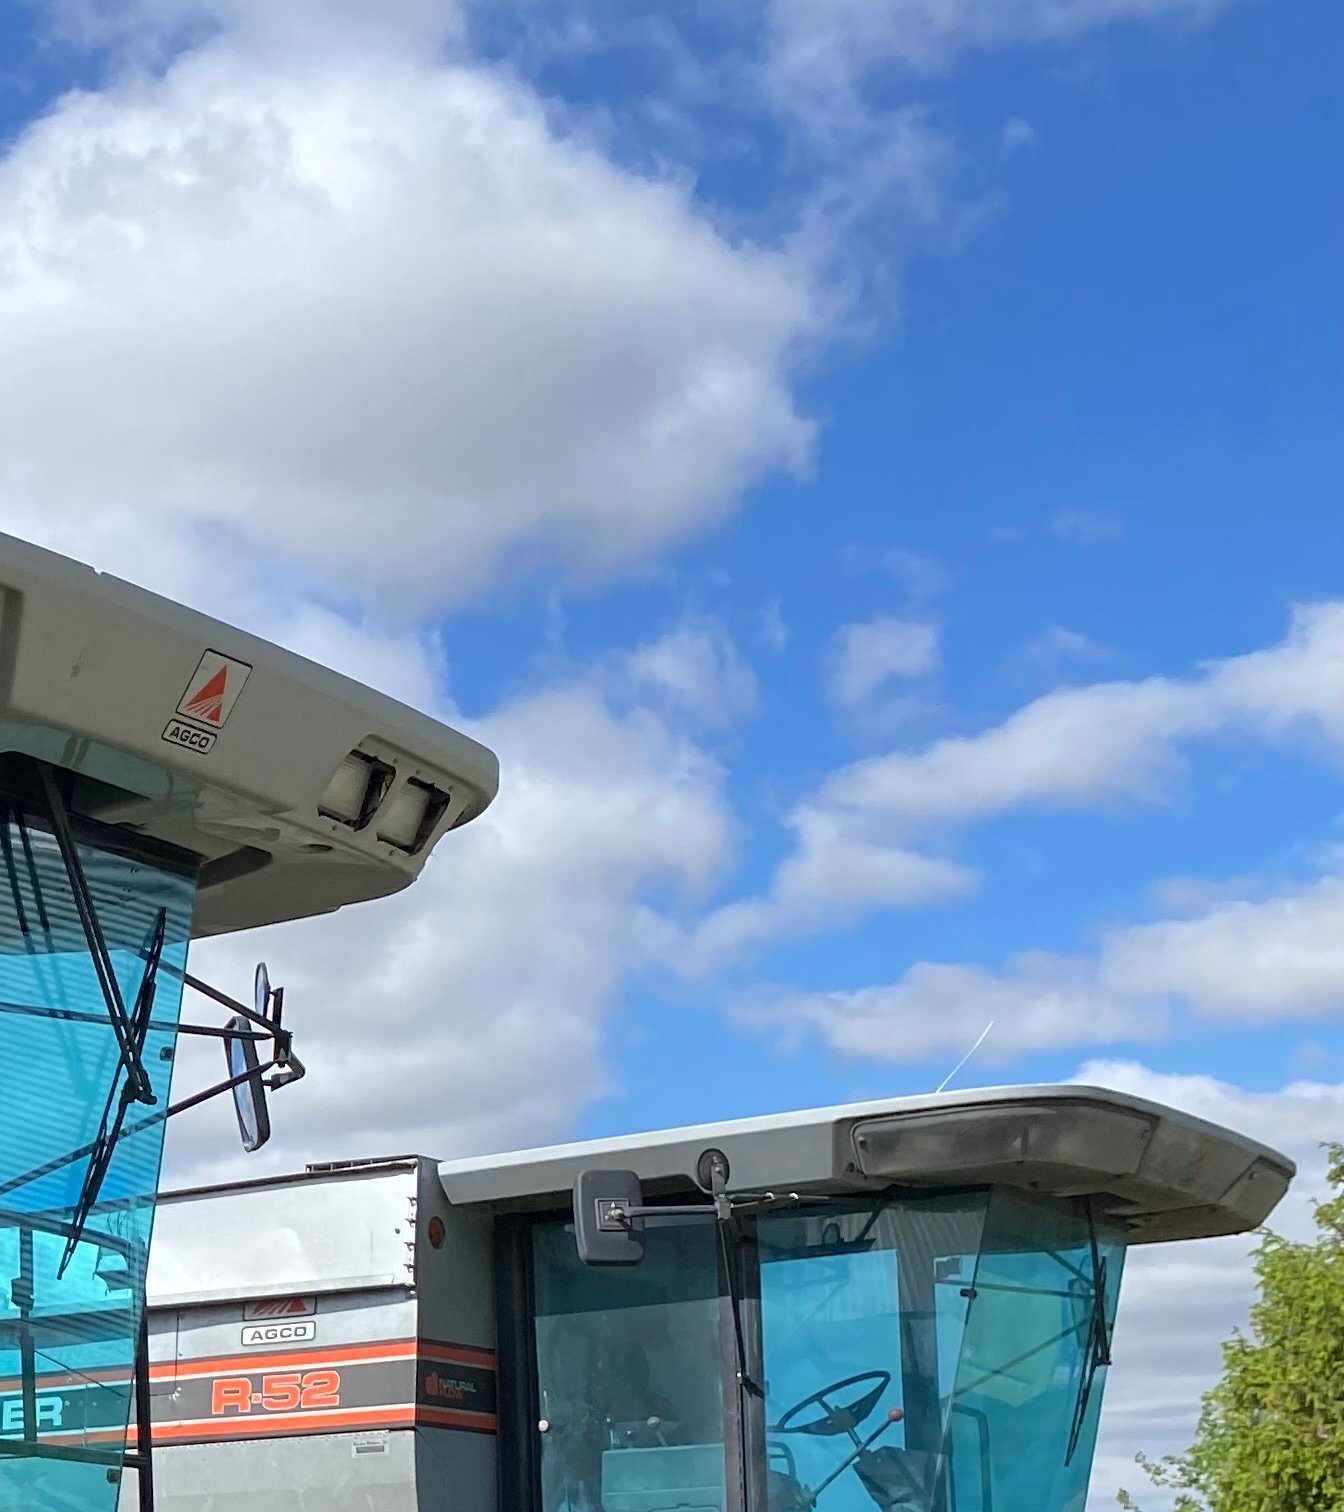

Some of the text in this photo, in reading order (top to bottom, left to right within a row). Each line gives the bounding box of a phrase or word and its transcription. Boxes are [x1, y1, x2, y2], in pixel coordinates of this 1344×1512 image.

[169, 726, 210, 749] AGCO
[250, 1325, 307, 1342] AGCO
[211, 1370, 341, 1415] R-52
